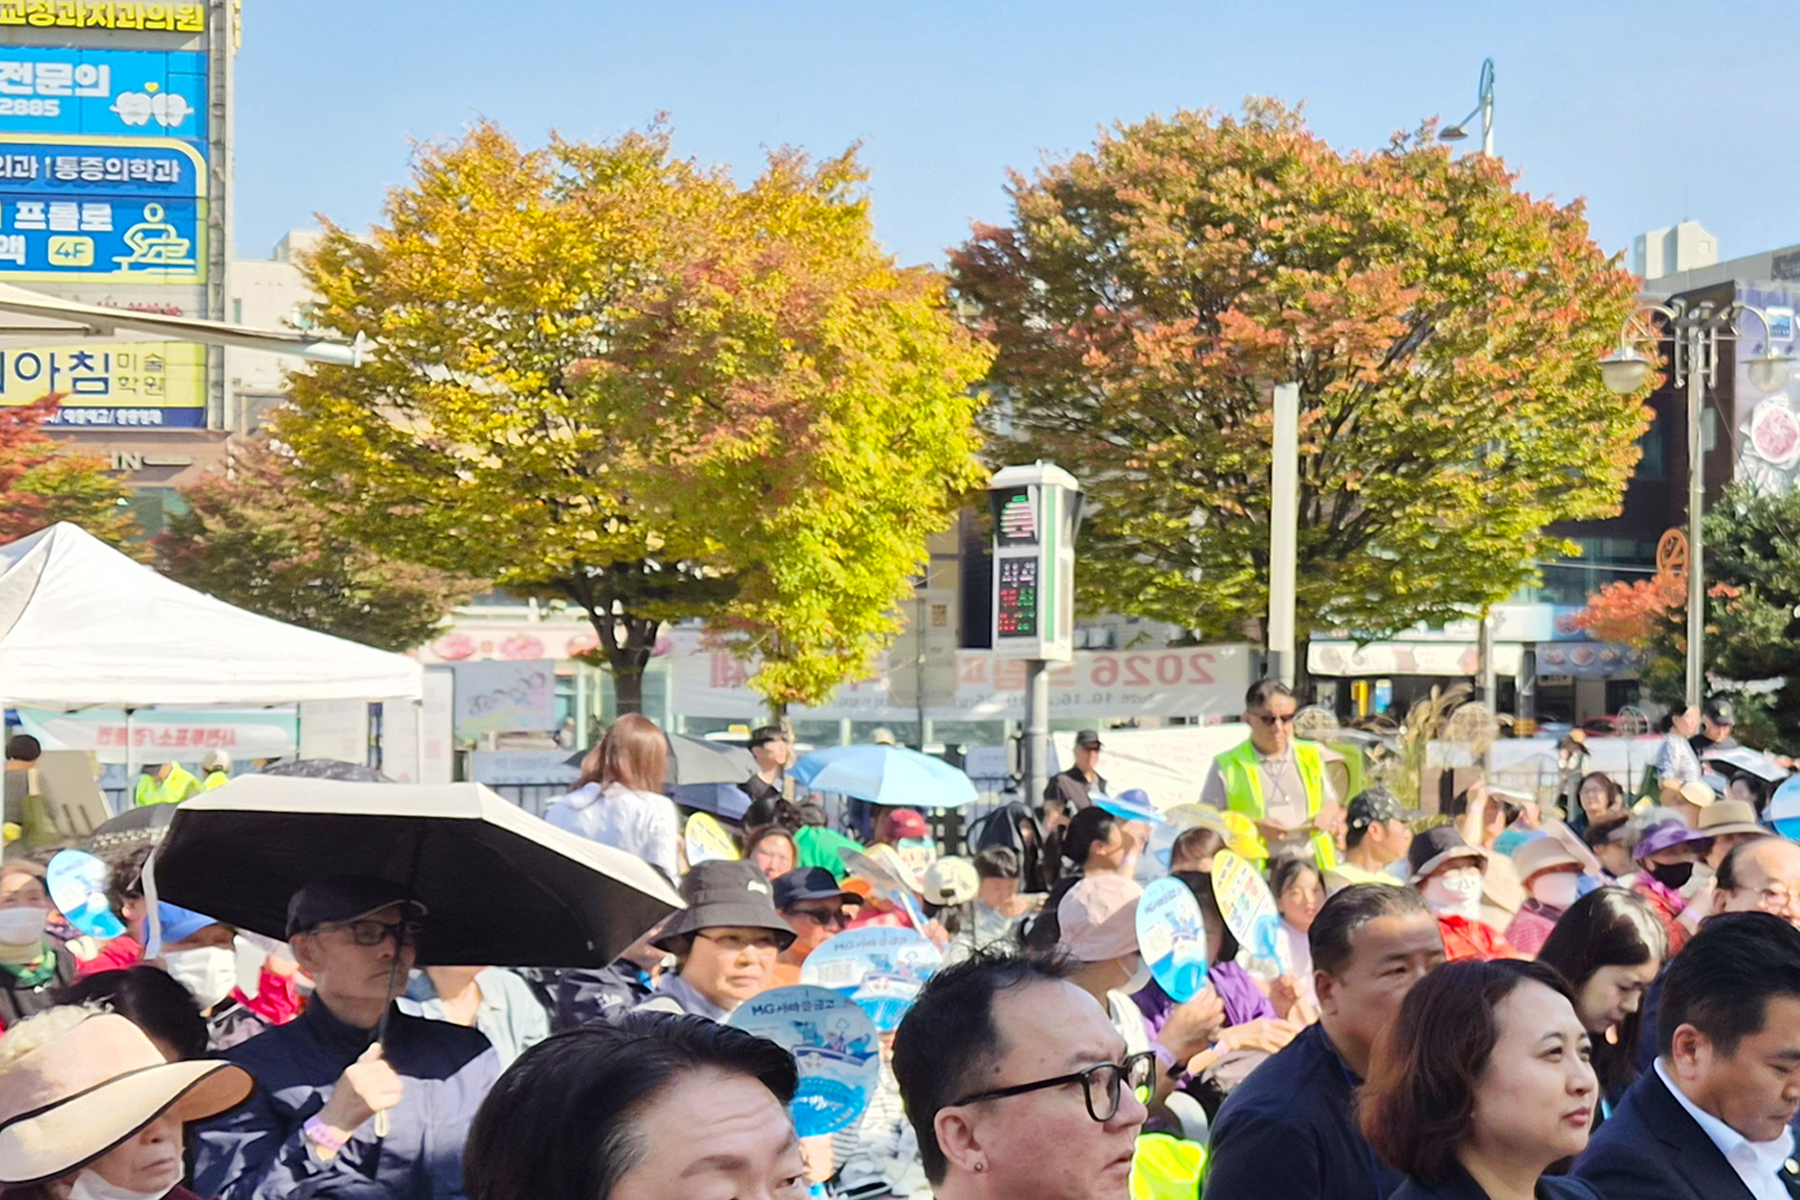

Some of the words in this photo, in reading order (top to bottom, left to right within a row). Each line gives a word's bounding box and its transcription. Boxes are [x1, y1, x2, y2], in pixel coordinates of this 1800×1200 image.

[0, 61, 110, 97] 전문의
[54, 156, 182, 182] 통증의학과
[54, 241, 87, 259] 4F
[0, 350, 110, 395] 아침
